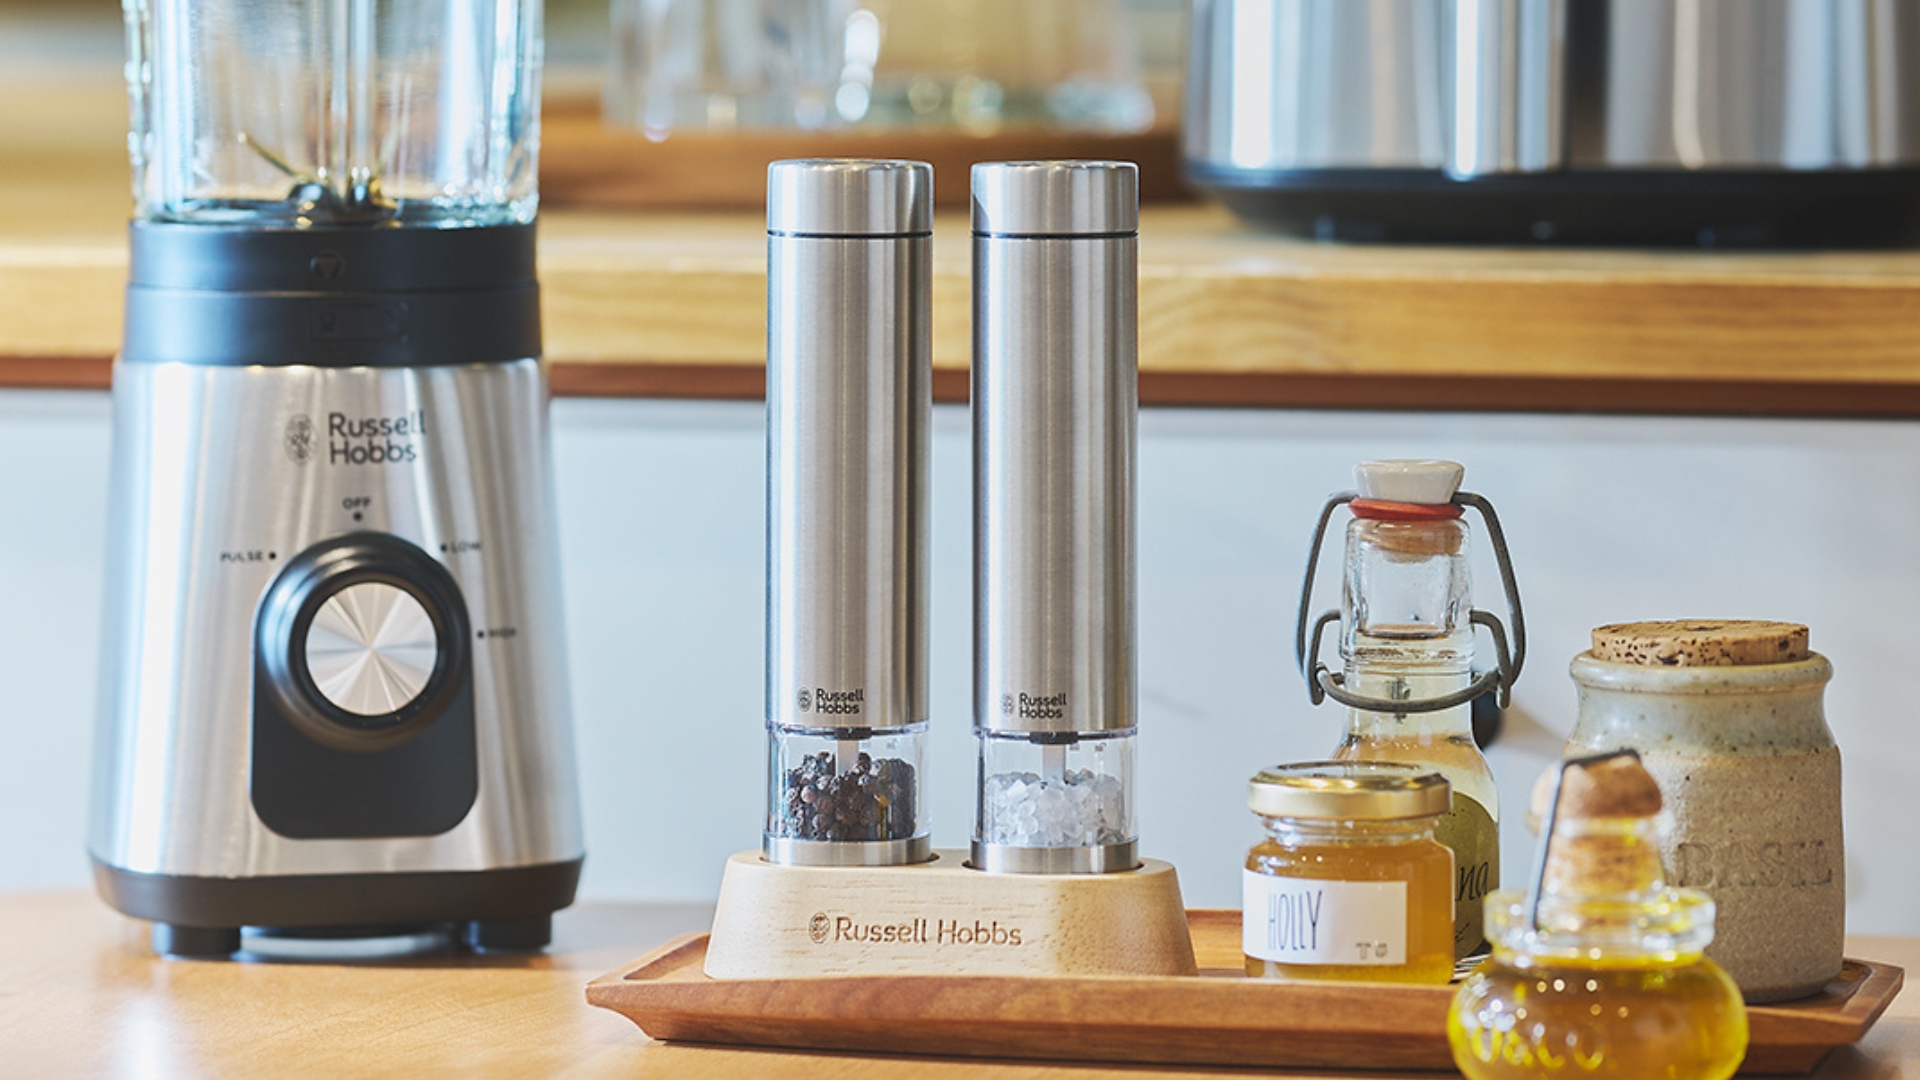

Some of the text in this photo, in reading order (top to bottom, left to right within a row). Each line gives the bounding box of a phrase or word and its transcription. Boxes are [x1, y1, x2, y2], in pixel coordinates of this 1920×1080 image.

[329, 410, 426, 438] Russell
[330, 439, 417, 465] Hobbs
[342, 497, 371, 510] OFF
[220, 551, 263, 562] PULSE
[816, 688, 864, 702] Russell
[1019, 692, 1067, 706] Russell
[816, 701, 860, 714] Hobbs
[1019, 706, 1063, 719] Hobbs
[1678, 841, 1832, 887] BASIL
[1267, 890, 1323, 951] HOLLY
[835, 916, 1022, 946] Russell Hobbs
